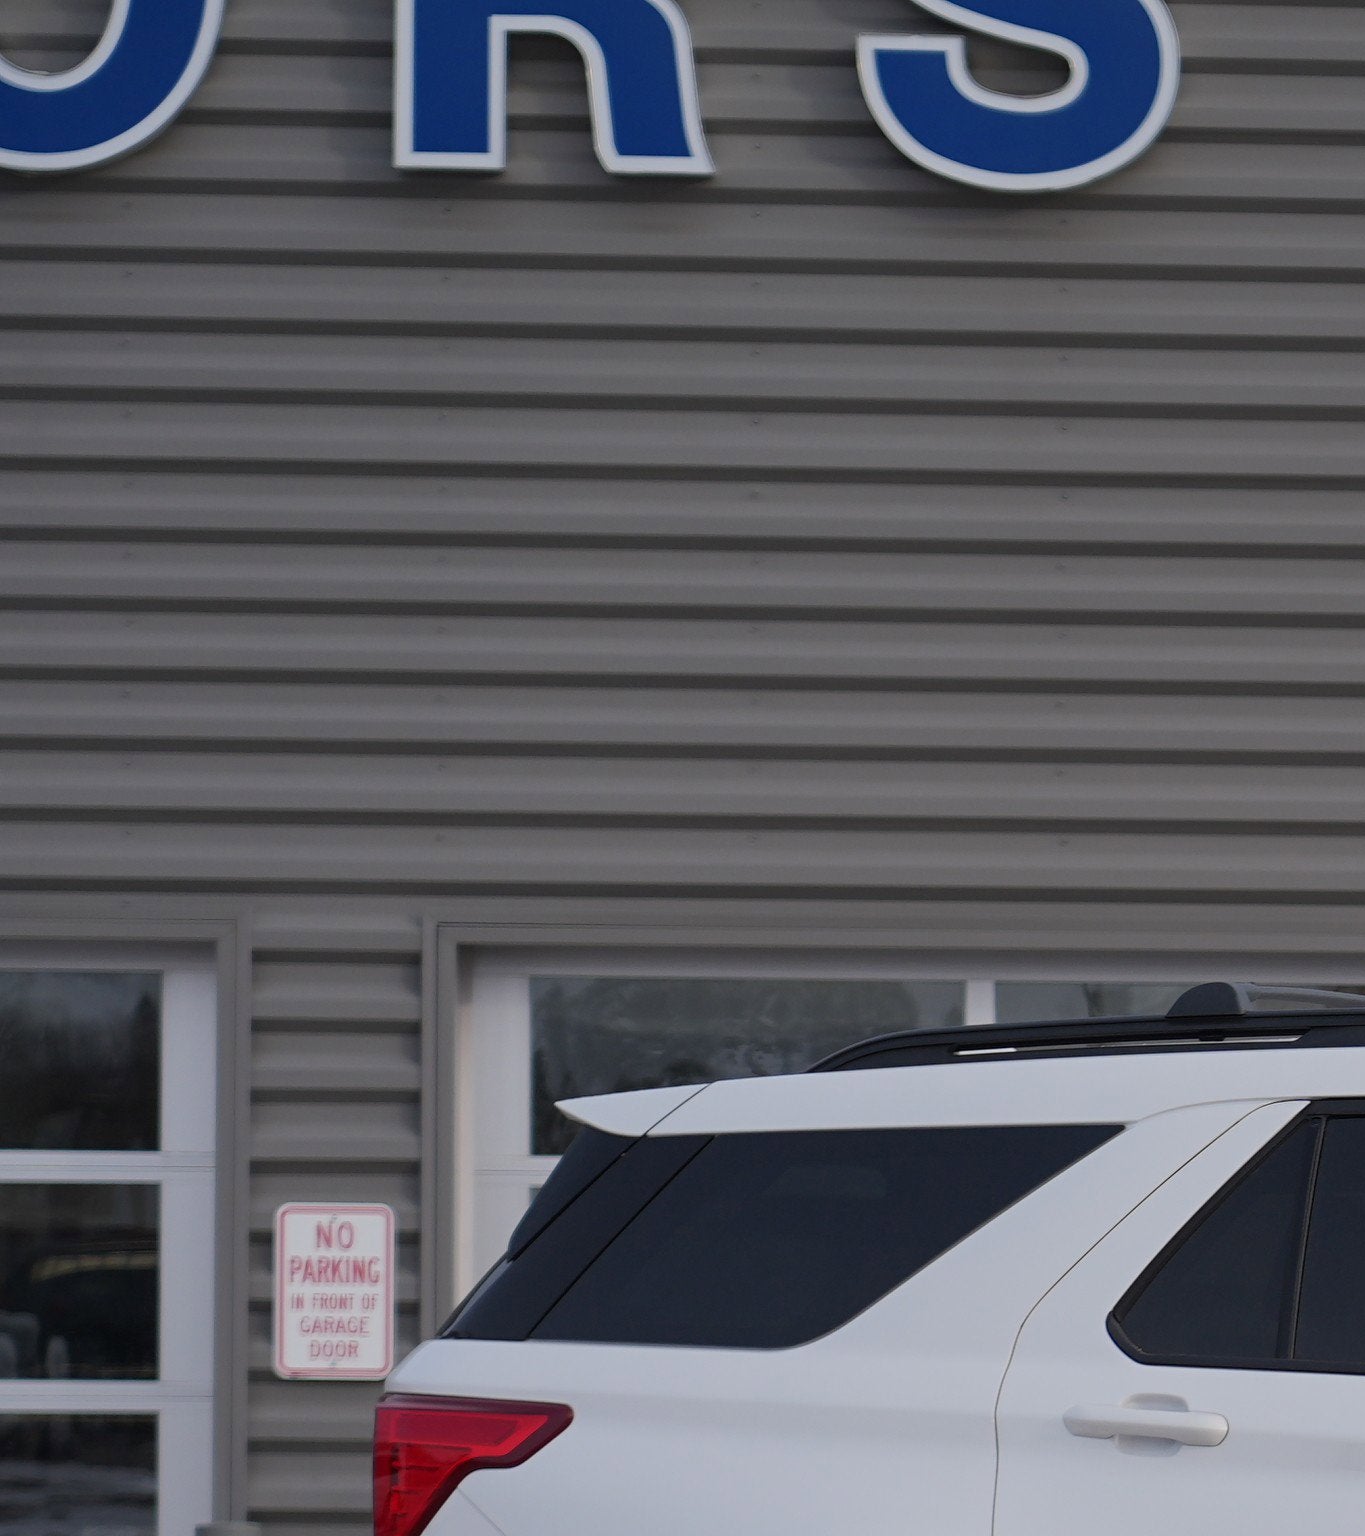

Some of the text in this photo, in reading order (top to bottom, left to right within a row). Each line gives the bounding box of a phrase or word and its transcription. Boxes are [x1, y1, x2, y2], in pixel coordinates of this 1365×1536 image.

[315, 1220, 355, 1249] NO
[288, 1255, 381, 1284] PARKING
[291, 1292, 380, 1310] IN FRONT OF
[300, 1315, 371, 1334] GARAGE
[309, 1339, 360, 1358] DOOR
